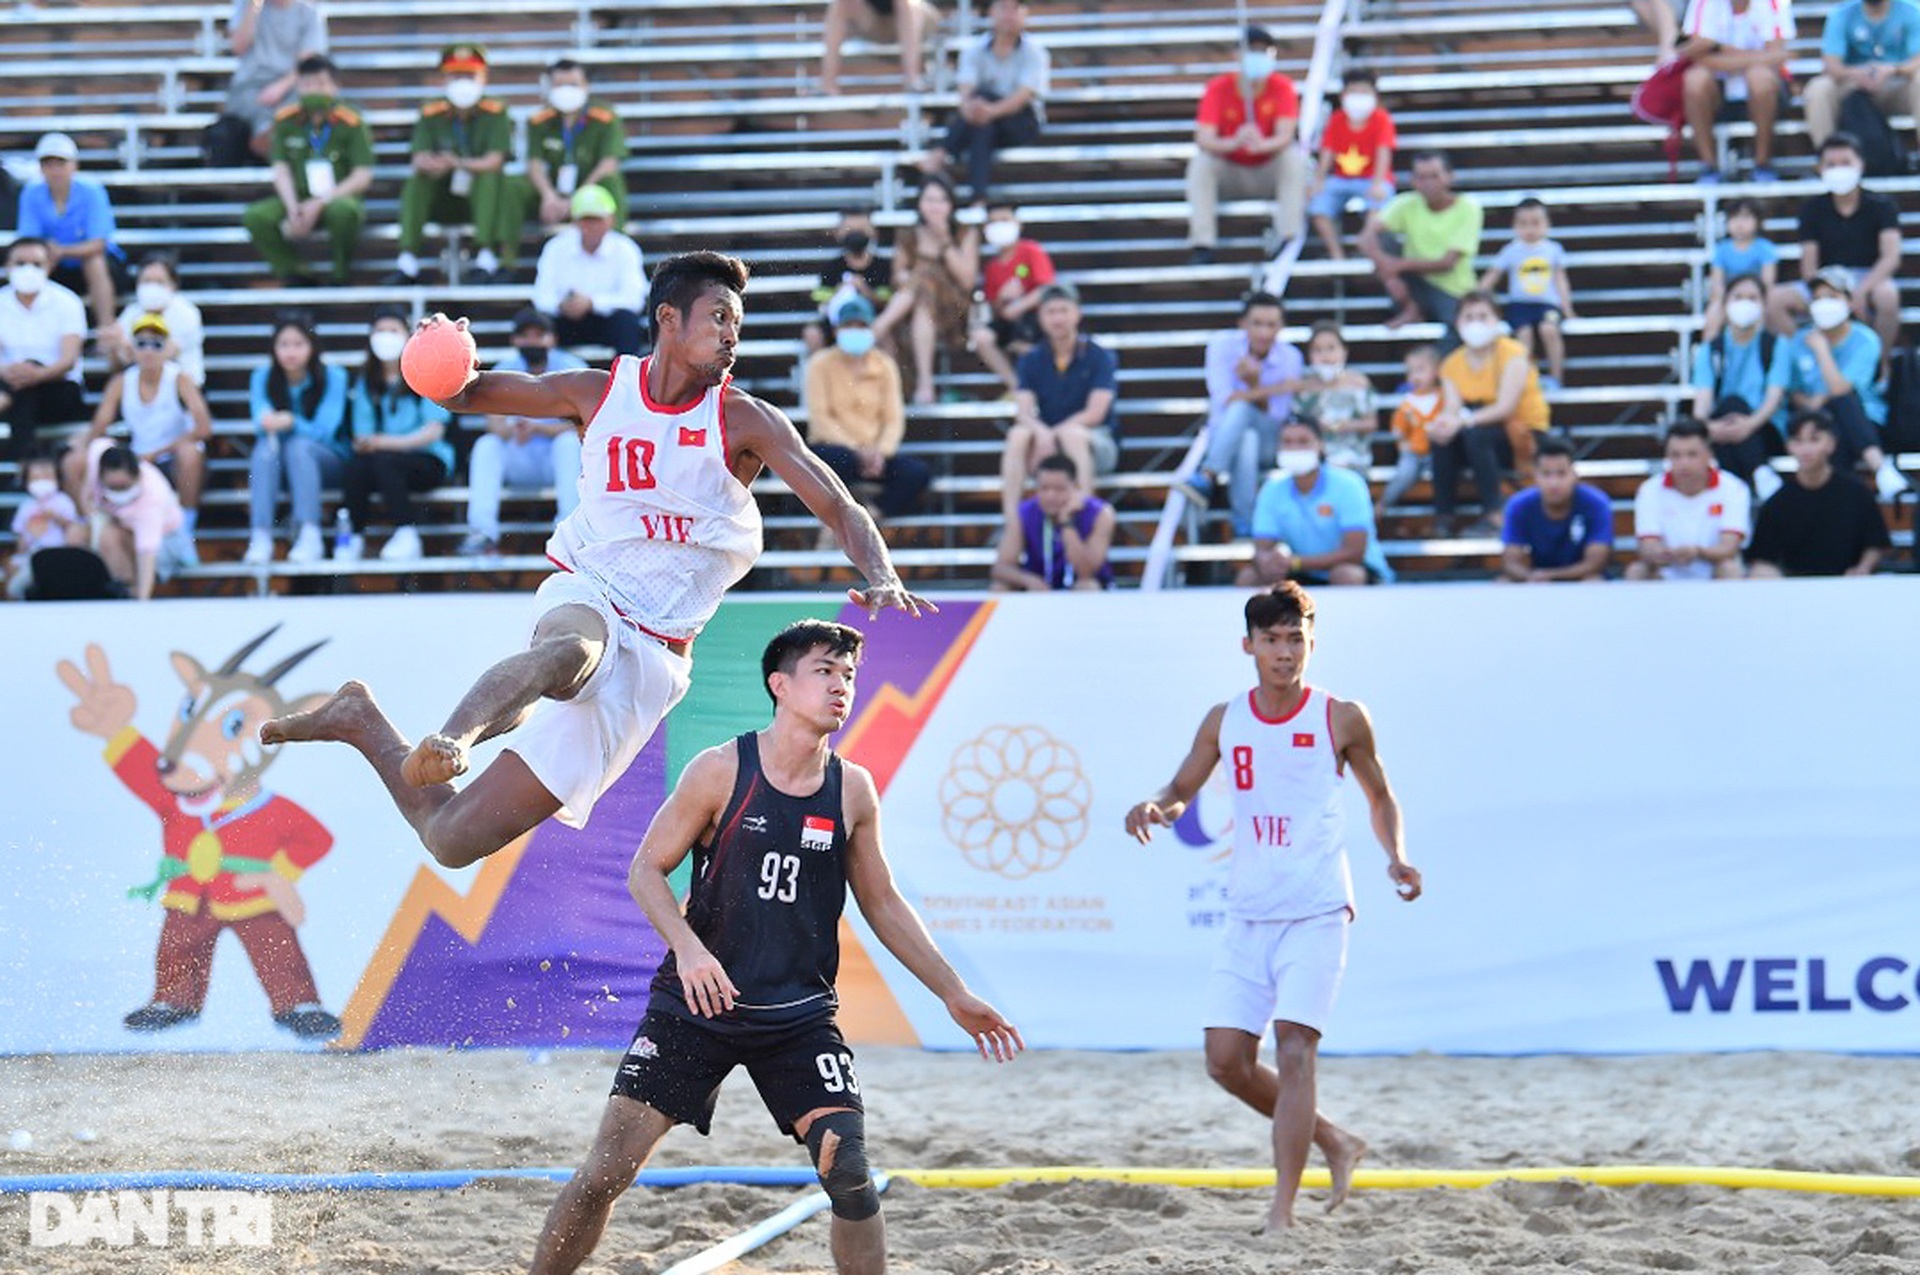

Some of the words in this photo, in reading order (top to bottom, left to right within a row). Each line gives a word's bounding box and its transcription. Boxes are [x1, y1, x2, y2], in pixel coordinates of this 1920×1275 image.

[606, 436, 657, 491] 10
[1233, 746, 1254, 791] 8
[1252, 815, 1292, 848] VIE
[758, 851, 801, 904] 93
[1655, 956, 1920, 1013] WELC
[815, 1053, 859, 1095] 93
